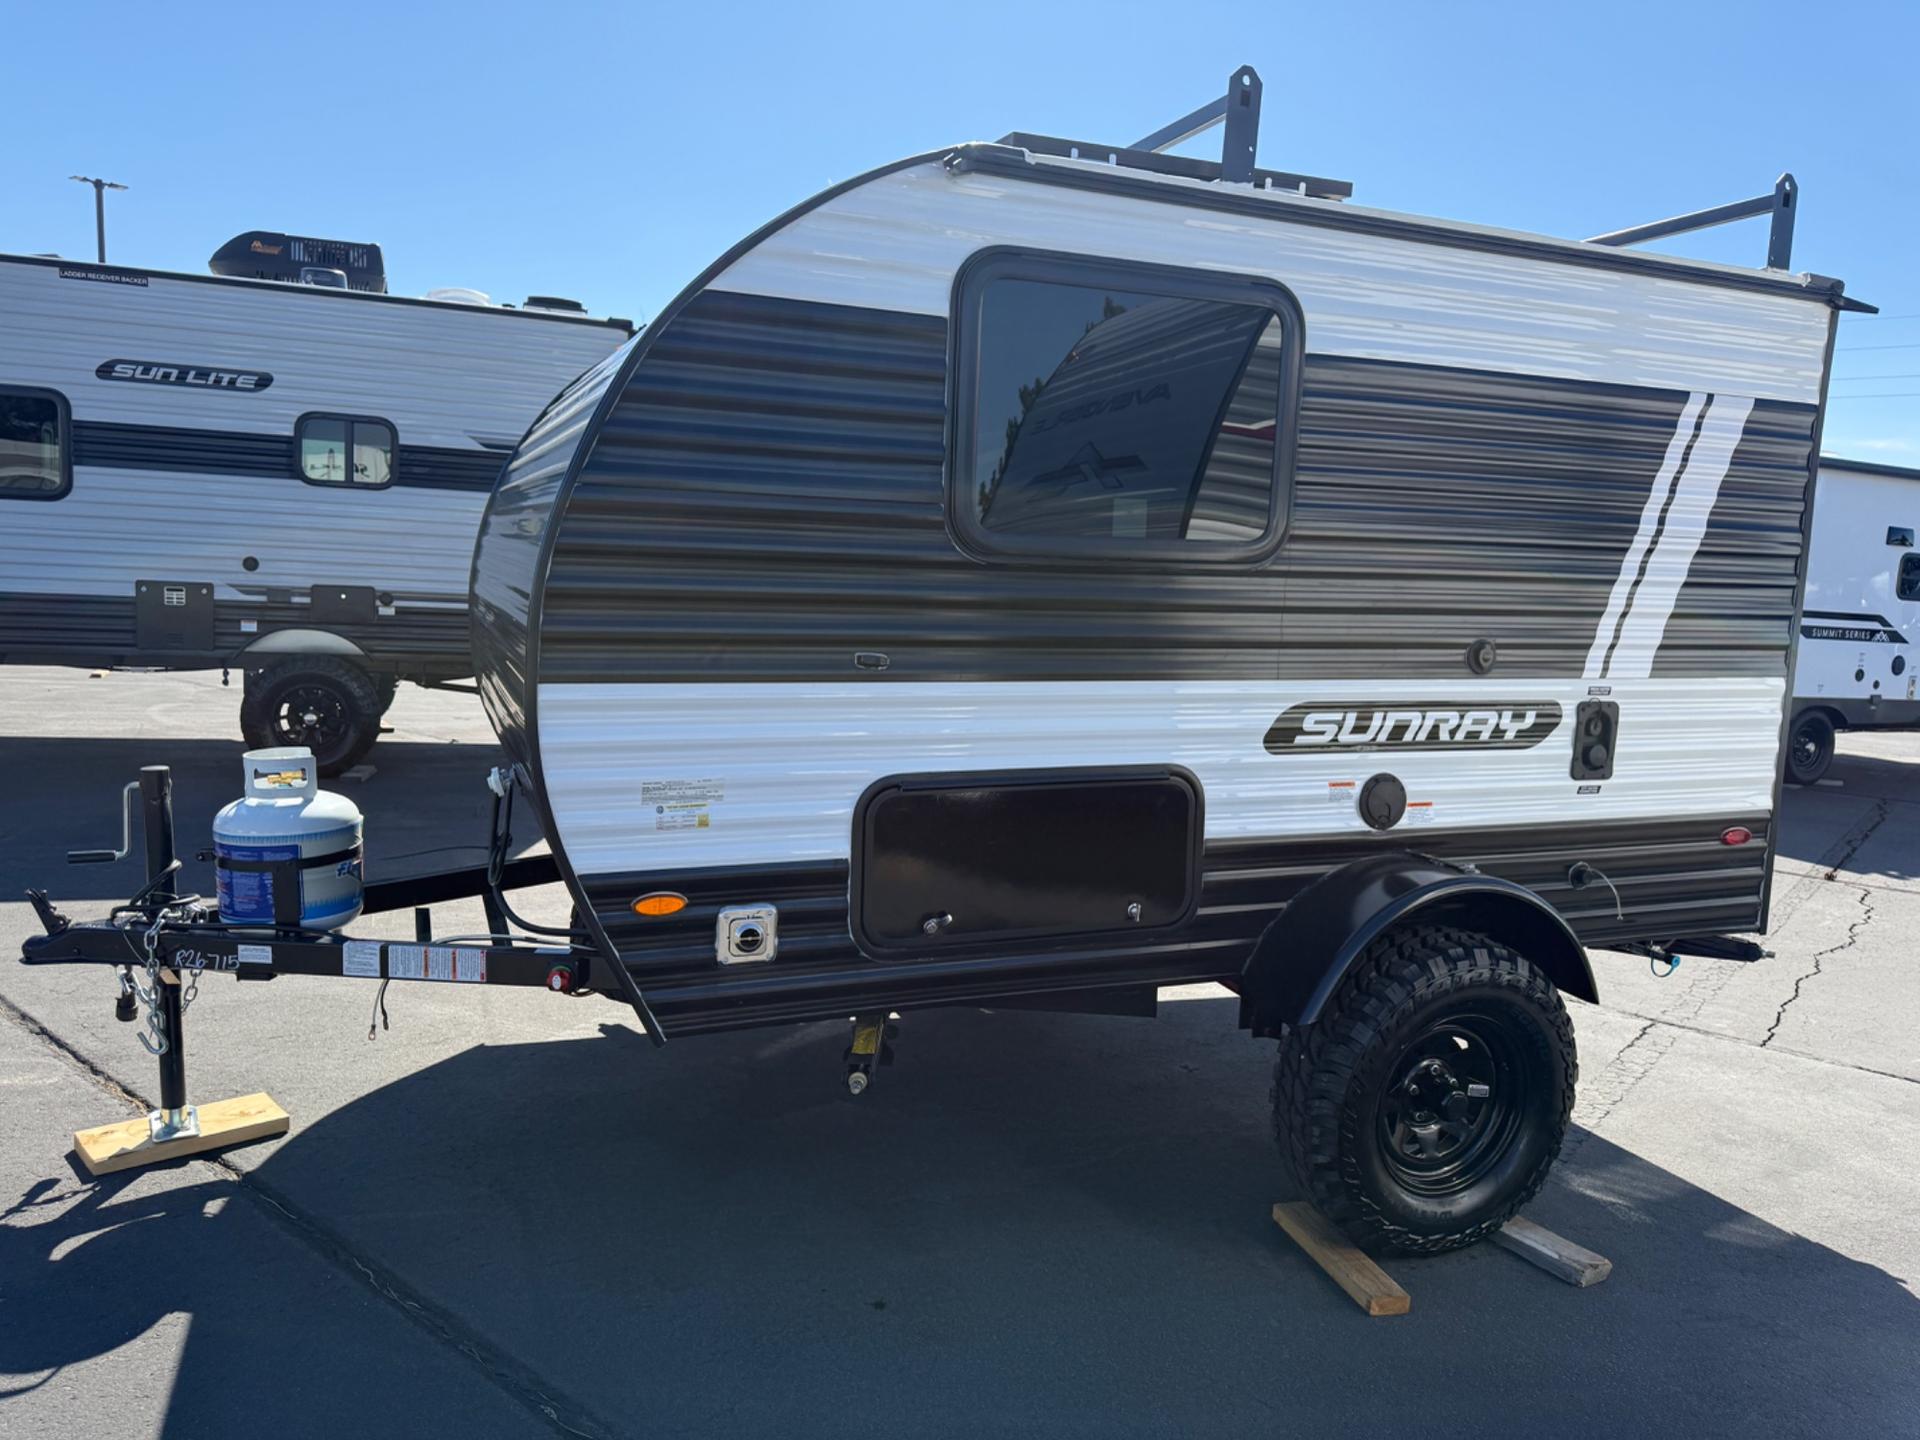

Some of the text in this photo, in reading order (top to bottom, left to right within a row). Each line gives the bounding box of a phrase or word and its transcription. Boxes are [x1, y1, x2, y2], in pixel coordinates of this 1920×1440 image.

[60, 270, 87, 278] LADDER
[112, 364, 259, 388] SUN LITE
[1812, 628, 1871, 640] SUMMIT SERIES
[1293, 711, 1537, 745] SUNRAY
